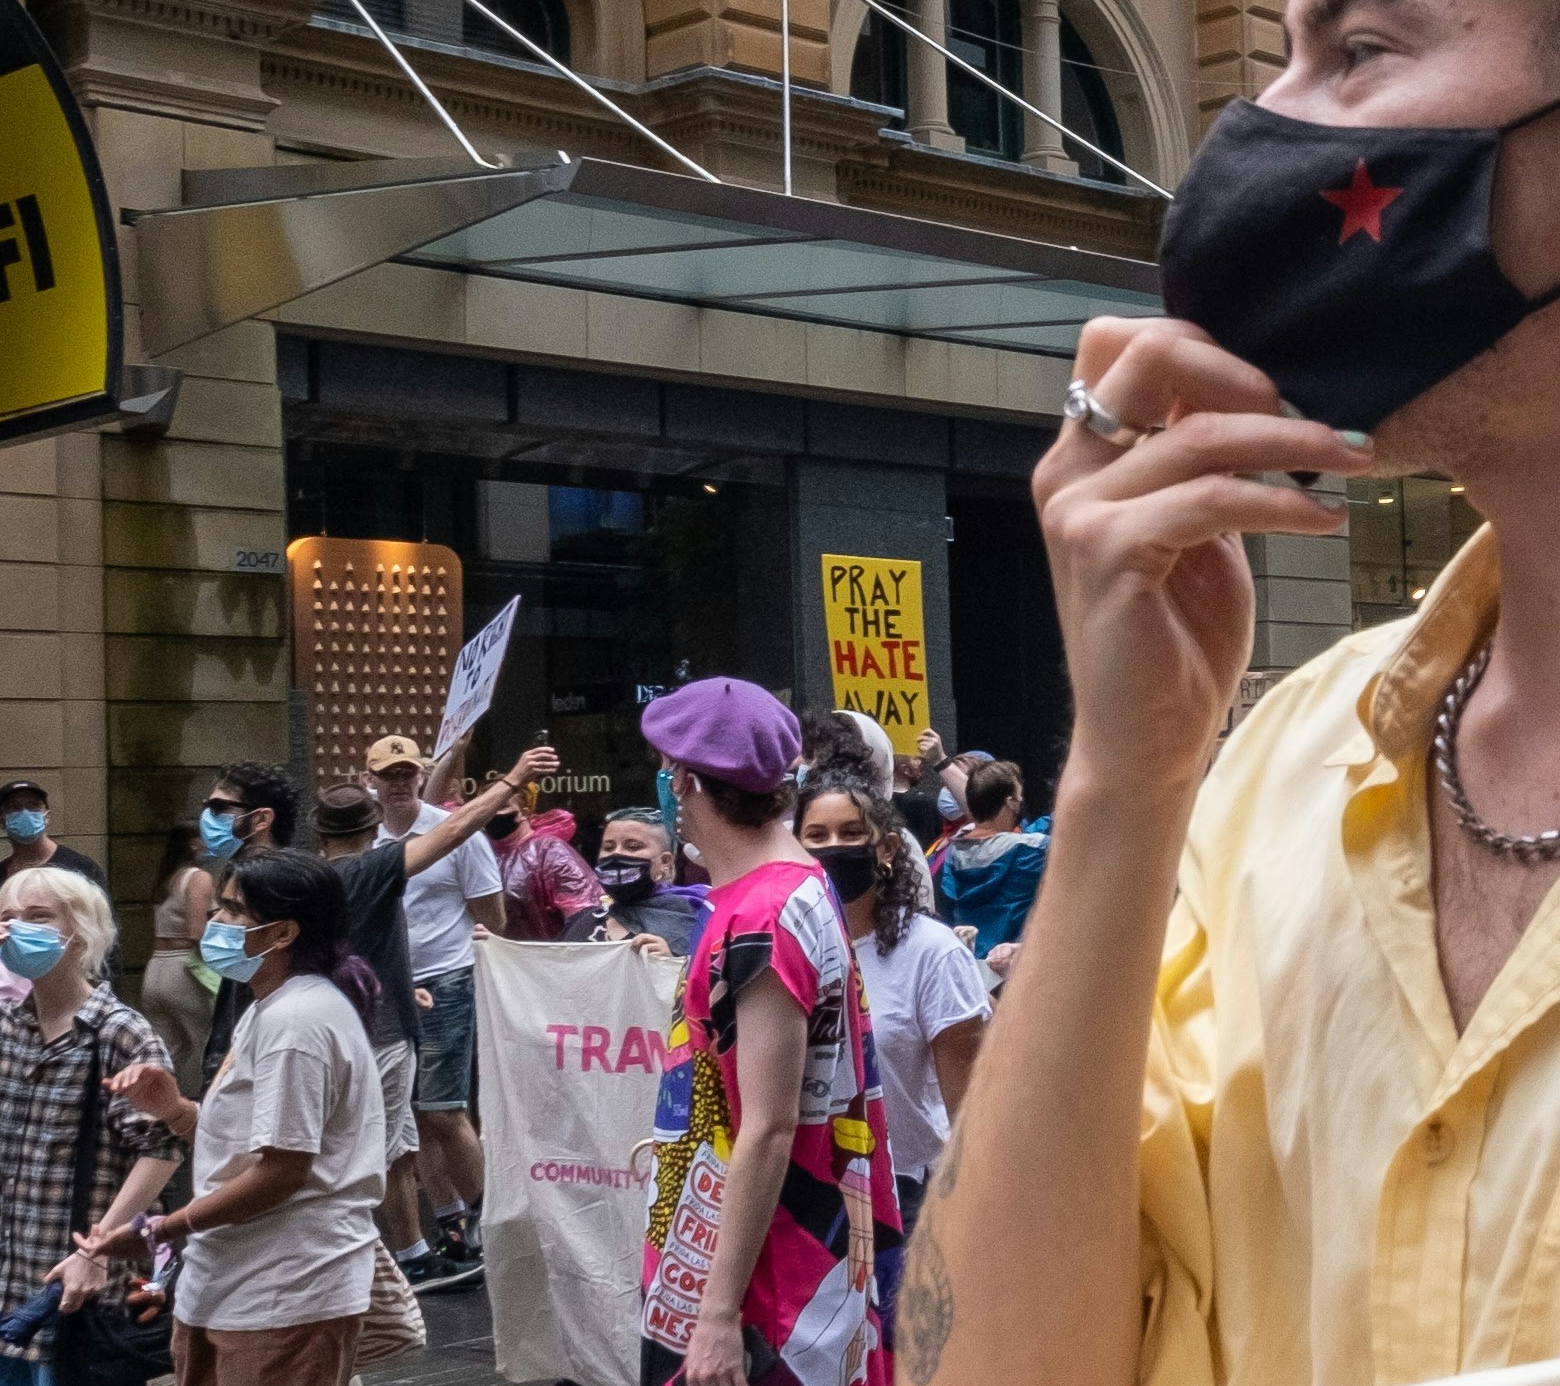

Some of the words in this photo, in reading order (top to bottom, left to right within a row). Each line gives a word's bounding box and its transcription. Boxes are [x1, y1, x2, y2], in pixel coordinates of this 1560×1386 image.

[831, 565, 907, 606] PRAY
[844, 606, 903, 639] THE
[833, 640, 924, 681] HATE
[844, 689, 919, 726] AWAY
